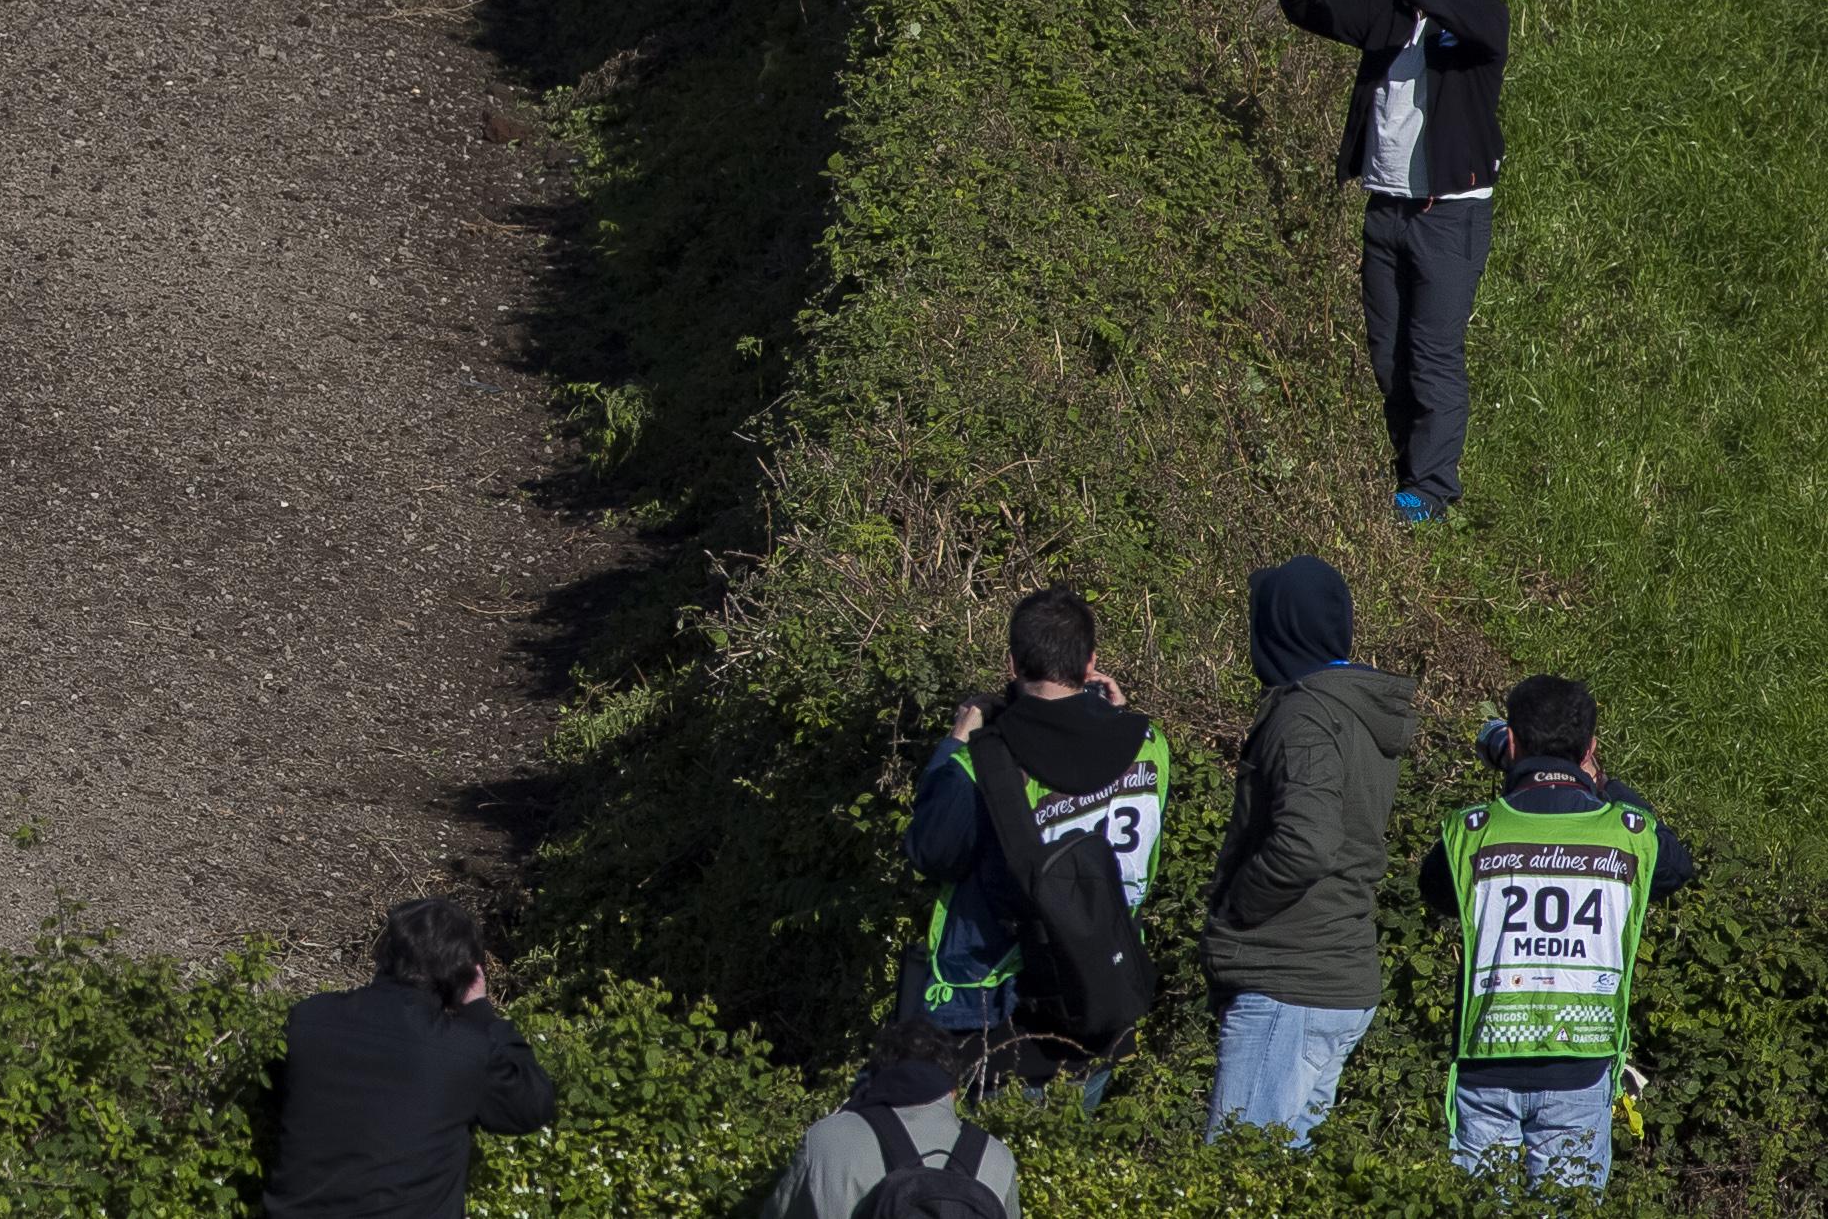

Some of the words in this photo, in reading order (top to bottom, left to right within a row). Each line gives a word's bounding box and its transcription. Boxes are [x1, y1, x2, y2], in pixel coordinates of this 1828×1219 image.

[1534, 771, 1576, 783] Canon
[1530, 845, 1589, 872] airlines
[1501, 885, 1604, 935] 204
[1514, 937, 1587, 959] MEDIA
